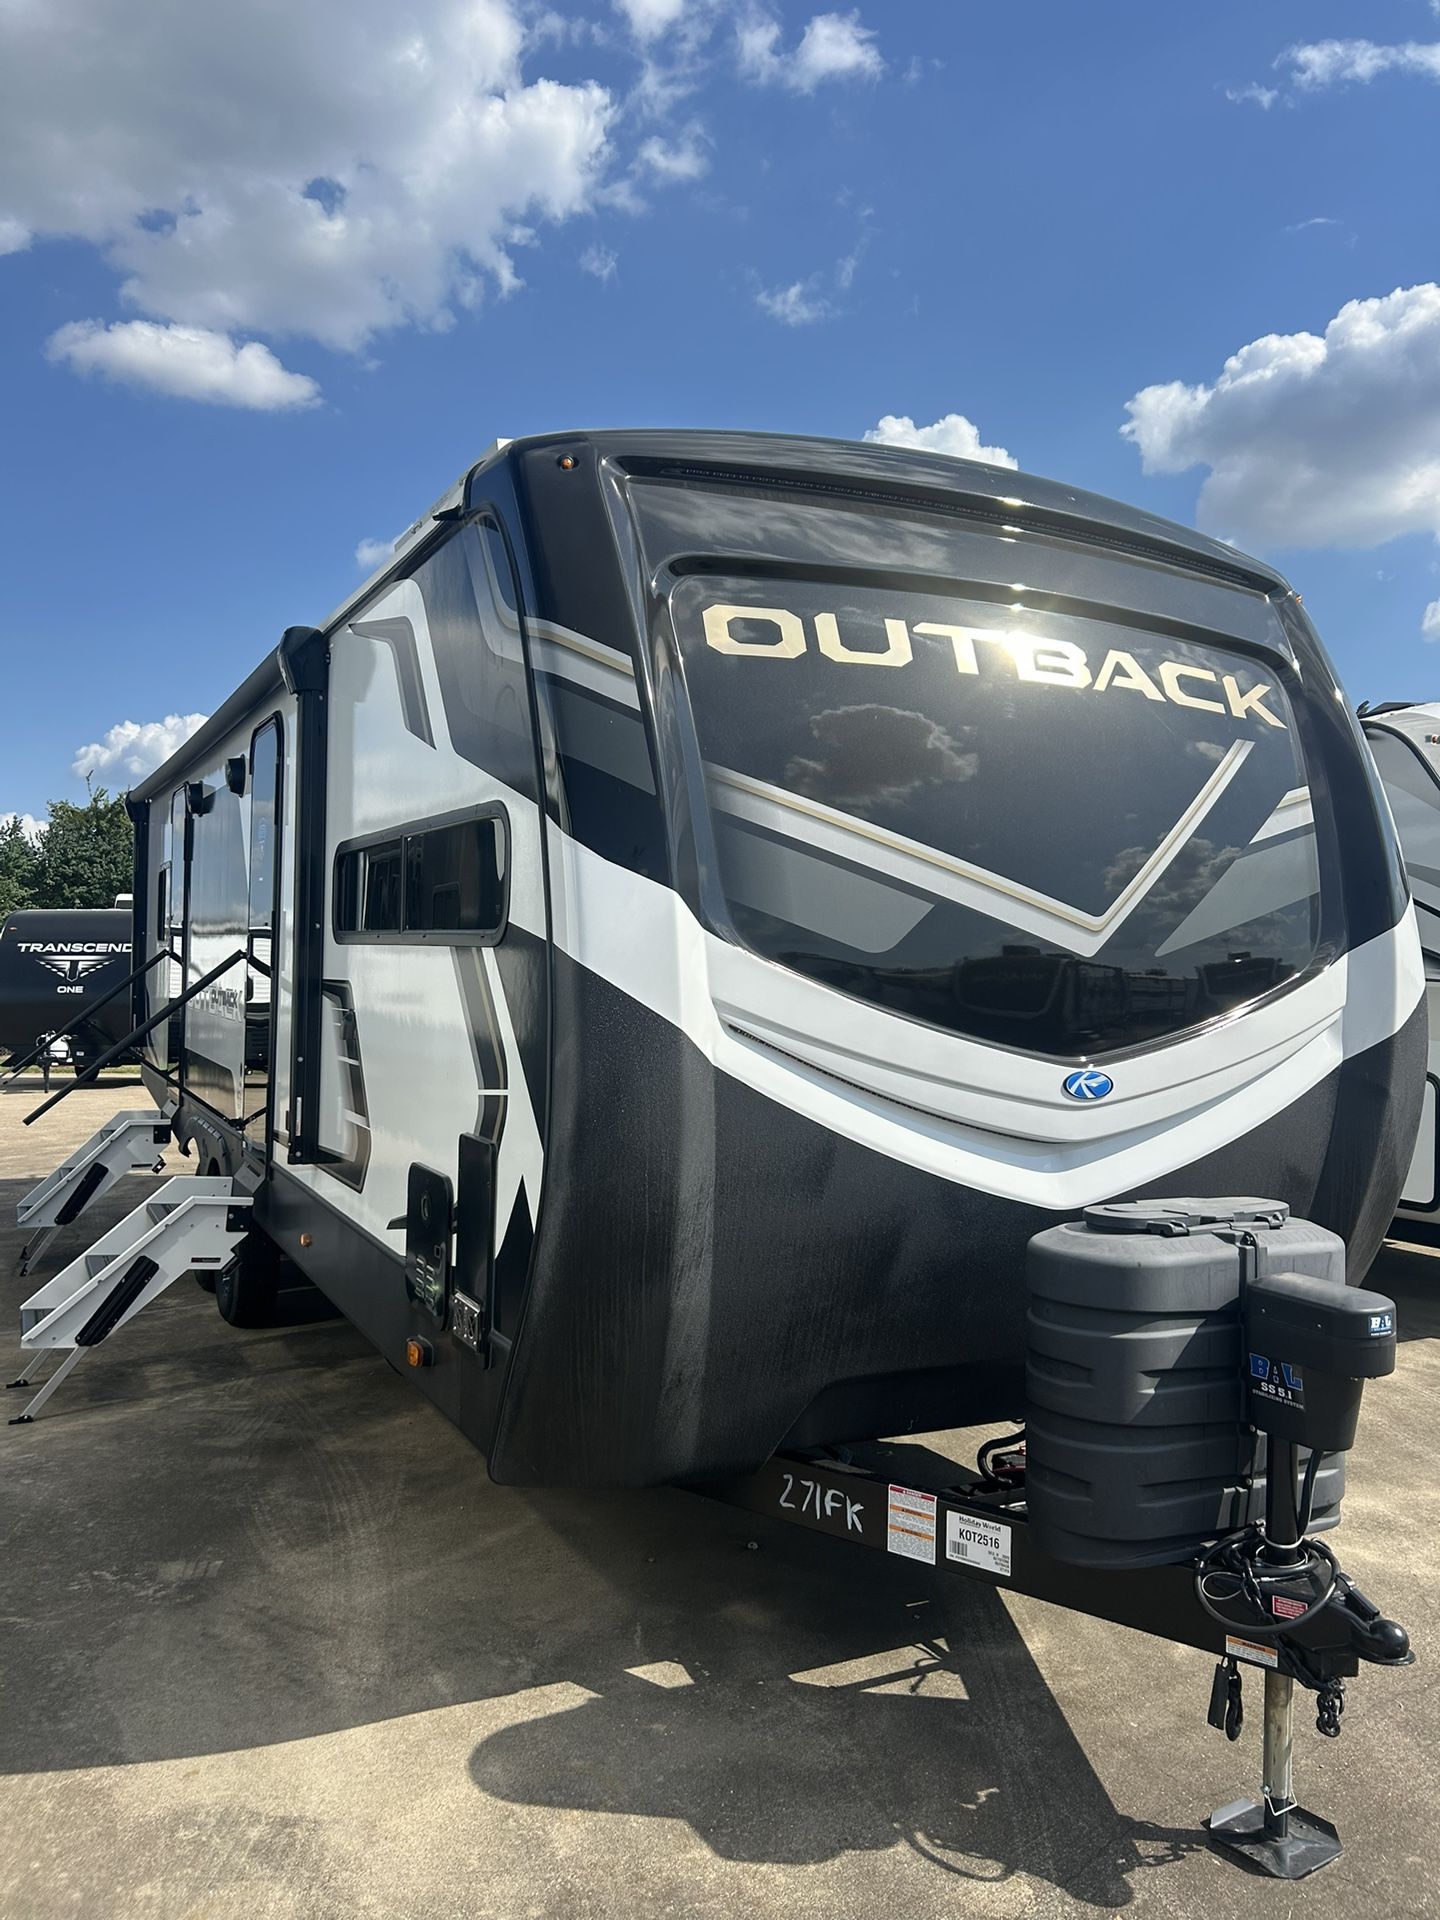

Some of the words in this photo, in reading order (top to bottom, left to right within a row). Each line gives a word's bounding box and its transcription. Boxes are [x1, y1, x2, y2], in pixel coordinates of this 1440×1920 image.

[702, 603, 1287, 730] OUTBACK
[56, 985, 84, 994] ONE
[1261, 1382, 1276, 1394] SS
[1278, 1387, 1292, 1400] 5.1
[779, 1473, 865, 1534] 271FK
[958, 1515, 982, 1529] Holiday
[982, 1521, 1001, 1533] World
